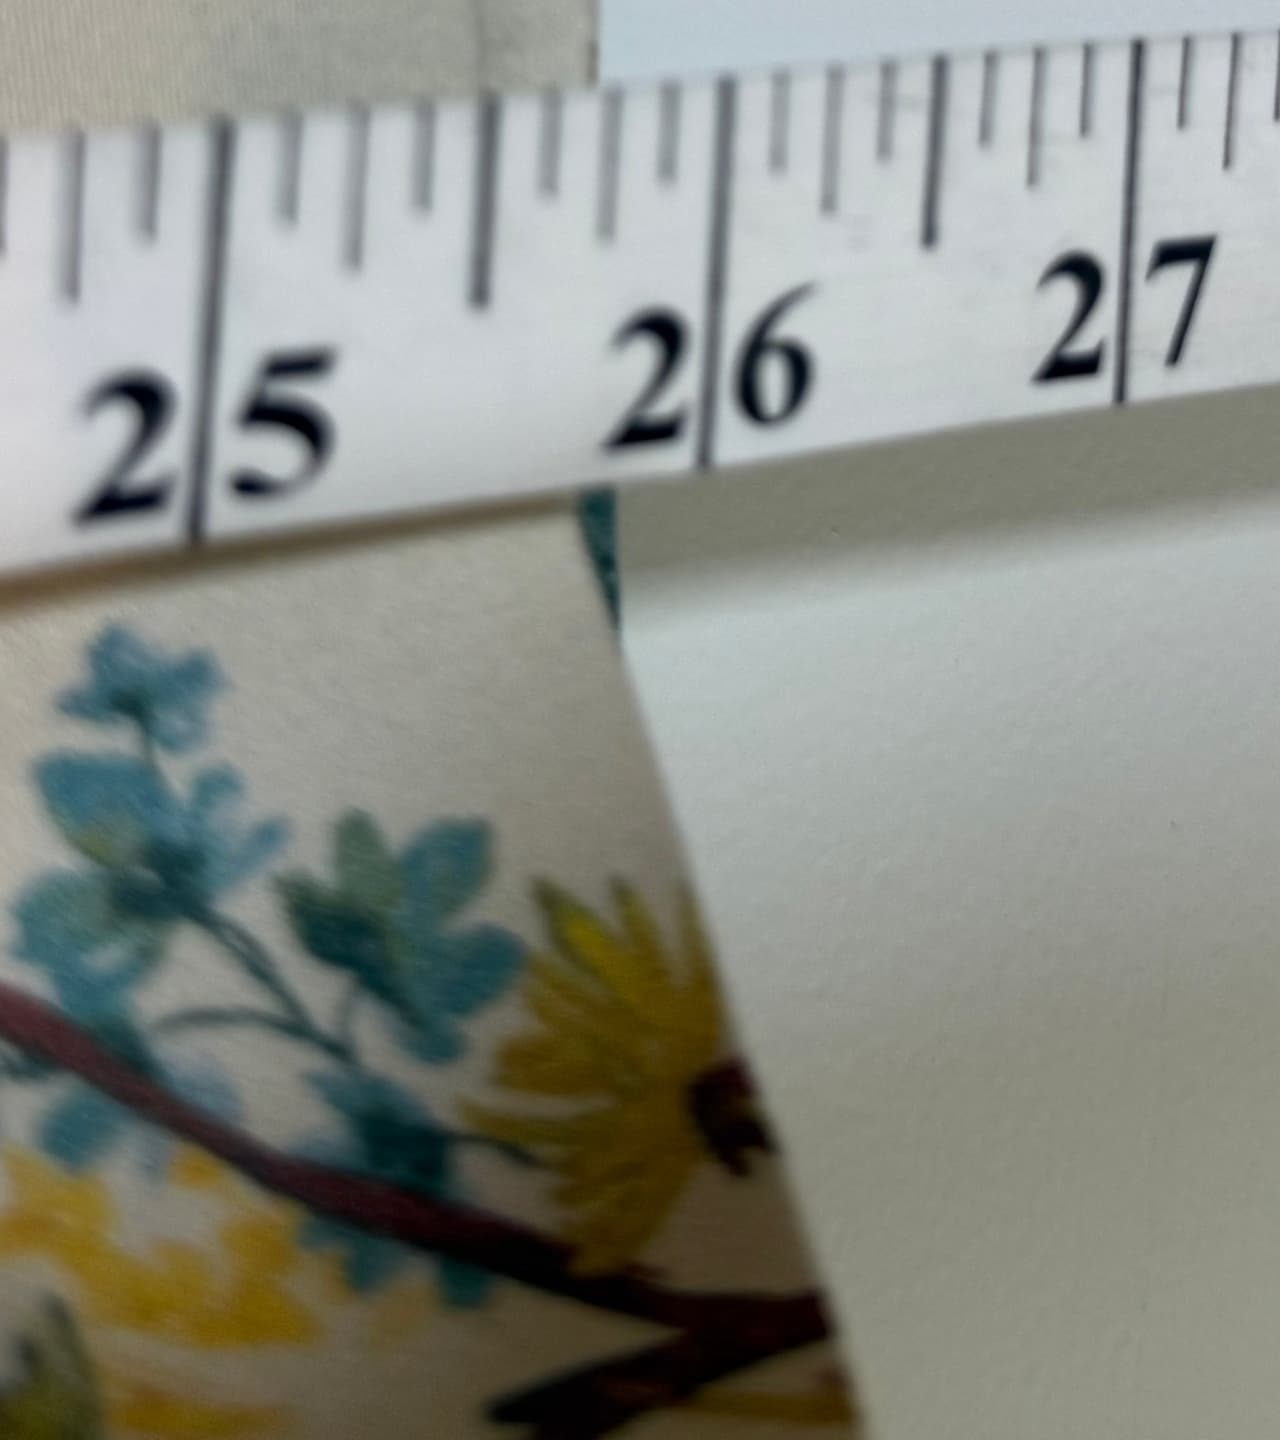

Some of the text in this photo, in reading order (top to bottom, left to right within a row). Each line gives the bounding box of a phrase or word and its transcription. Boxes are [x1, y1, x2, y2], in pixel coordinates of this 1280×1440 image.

[69, 344, 339, 526] 25
[601, 282, 818, 453] 26
[1030, 235, 1216, 386] 27
